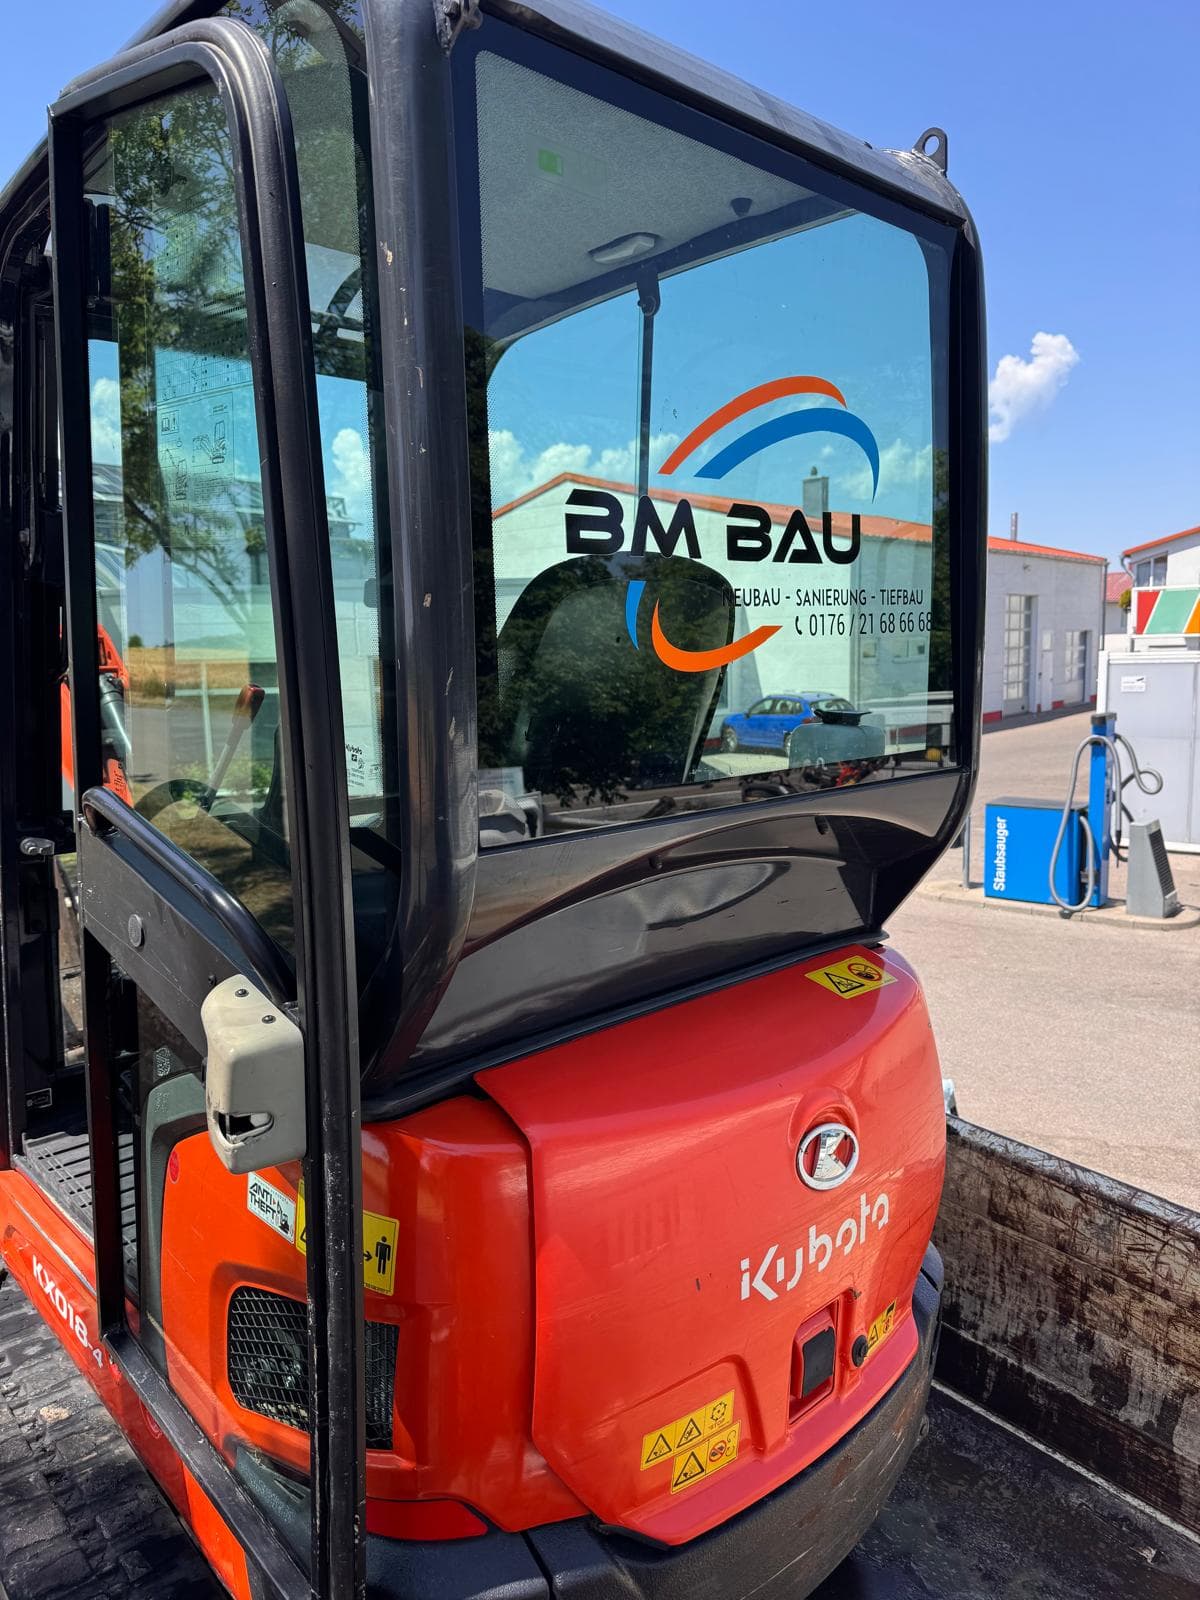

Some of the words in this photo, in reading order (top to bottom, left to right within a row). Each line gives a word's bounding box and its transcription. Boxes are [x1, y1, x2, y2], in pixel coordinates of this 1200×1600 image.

[565, 488, 702, 559] BM
[726, 502, 861, 564] BAU
[722, 588, 781, 607] NEUBAU
[796, 588, 867, 607] SANIERUNG
[880, 588, 924, 606] TIEFBAU
[809, 613, 845, 636] 0176
[859, 613, 873, 635] 21
[880, 612, 896, 634] 68
[899, 611, 915, 633] 66
[918, 611, 933, 633] 68
[993, 816, 1009, 892] Staubsauger
[249, 1190, 277, 1220] THEFT
[250, 1182, 273, 1205] ANTI
[740, 1192, 889, 1301] Kubota
